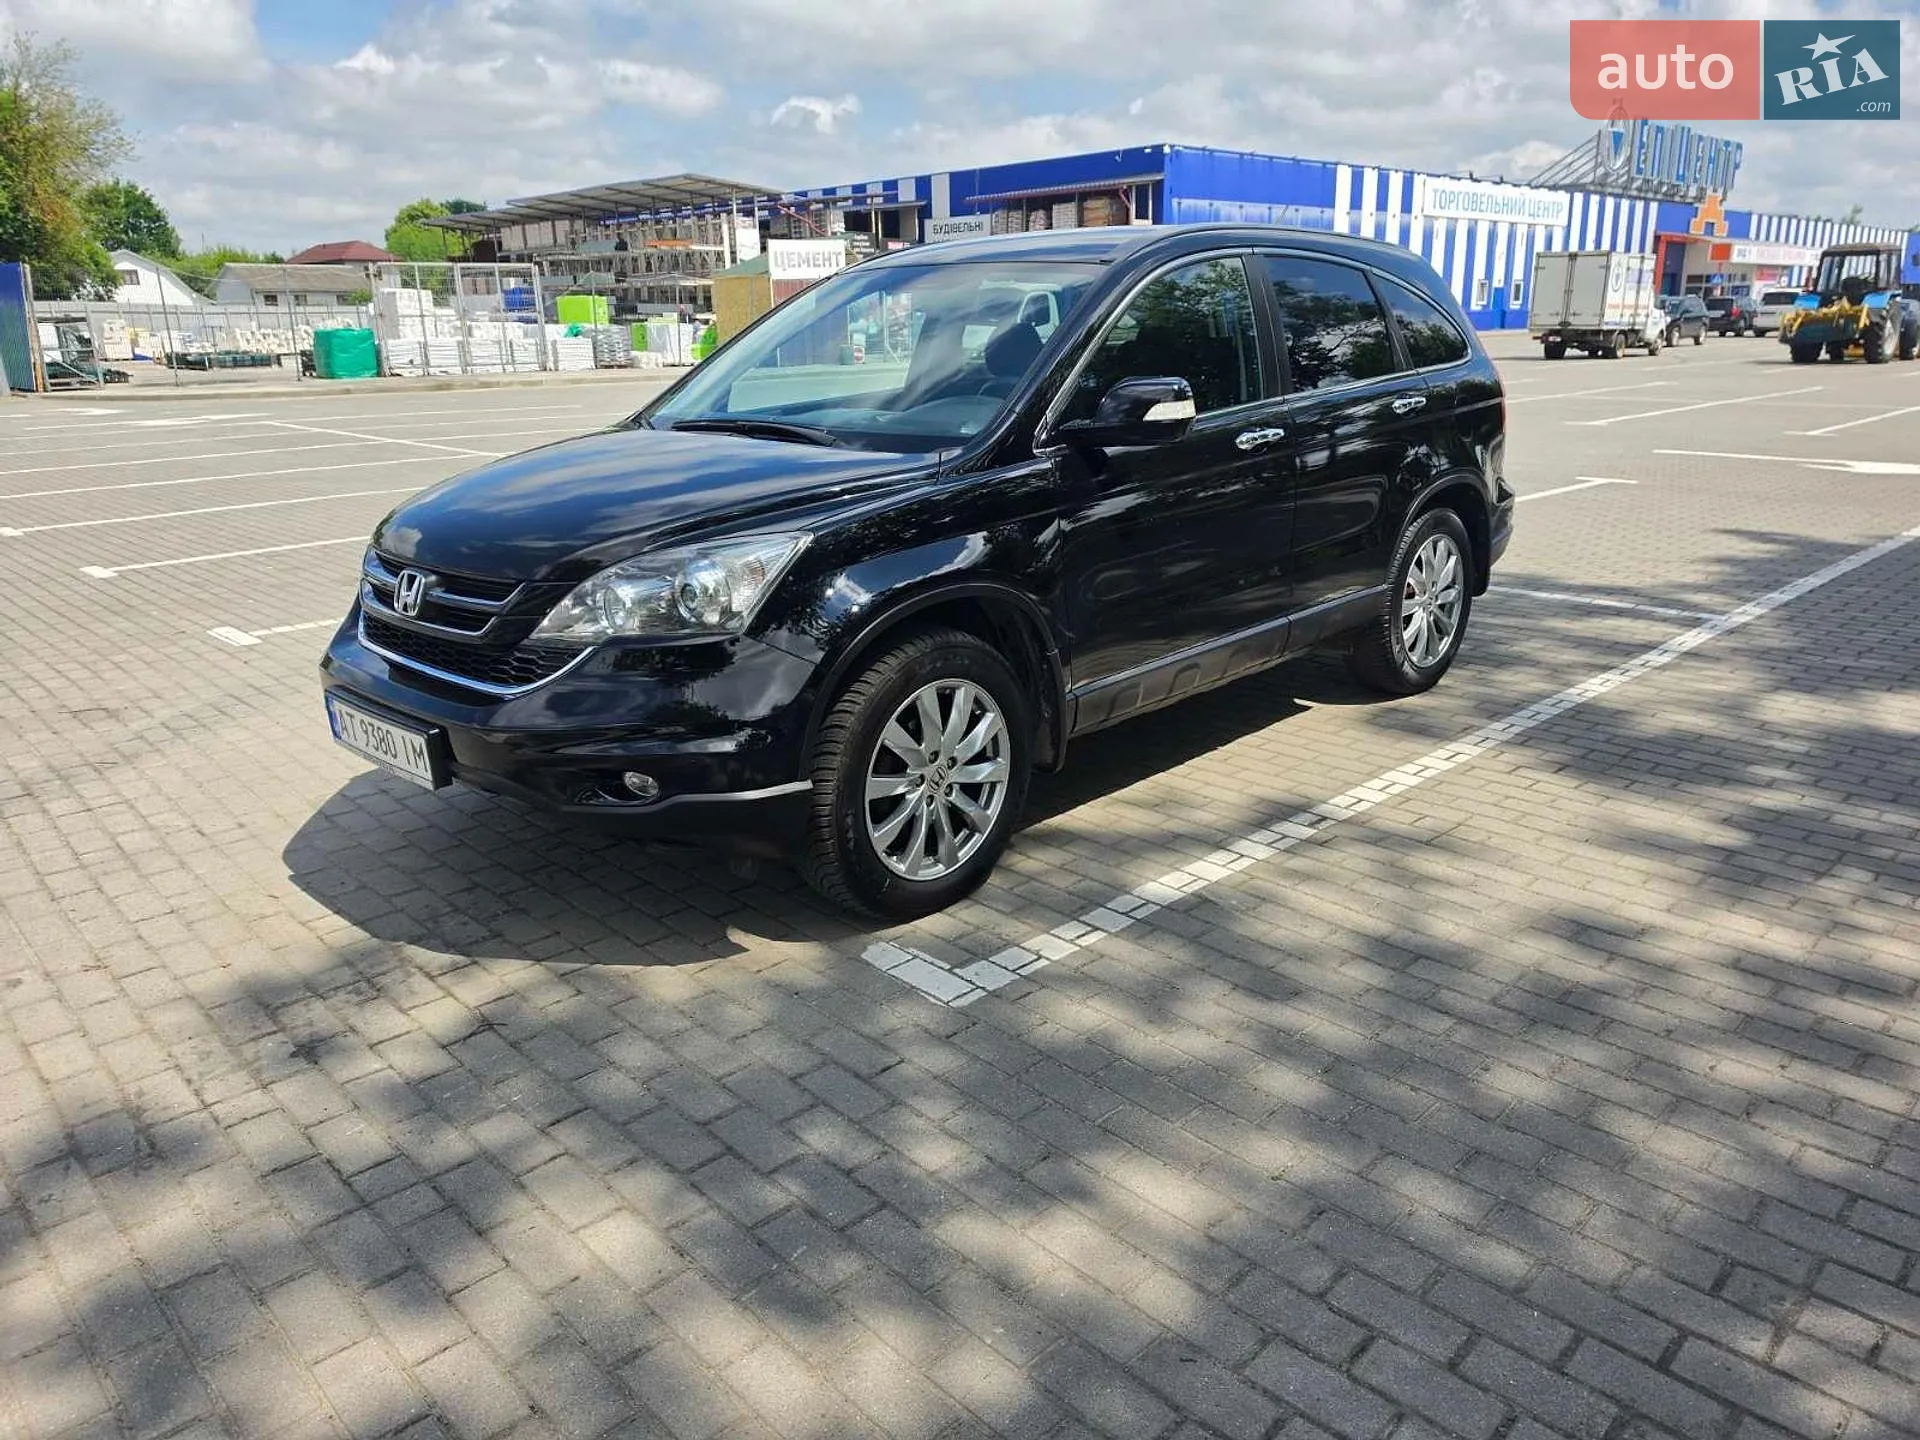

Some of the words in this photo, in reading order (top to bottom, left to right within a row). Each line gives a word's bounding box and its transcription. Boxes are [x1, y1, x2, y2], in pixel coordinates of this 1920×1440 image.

[1432, 188, 1526, 217] ТОРГОВЕЛЬНИЙ
[1527, 197, 1564, 220] ЦЕНТР
[932, 220, 984, 236] БУДІВЕЛЬНІ
[773, 250, 843, 272] ЦЕМЕНТ
[359, 718, 398, 760] 9380
[401, 735, 429, 774] IM
